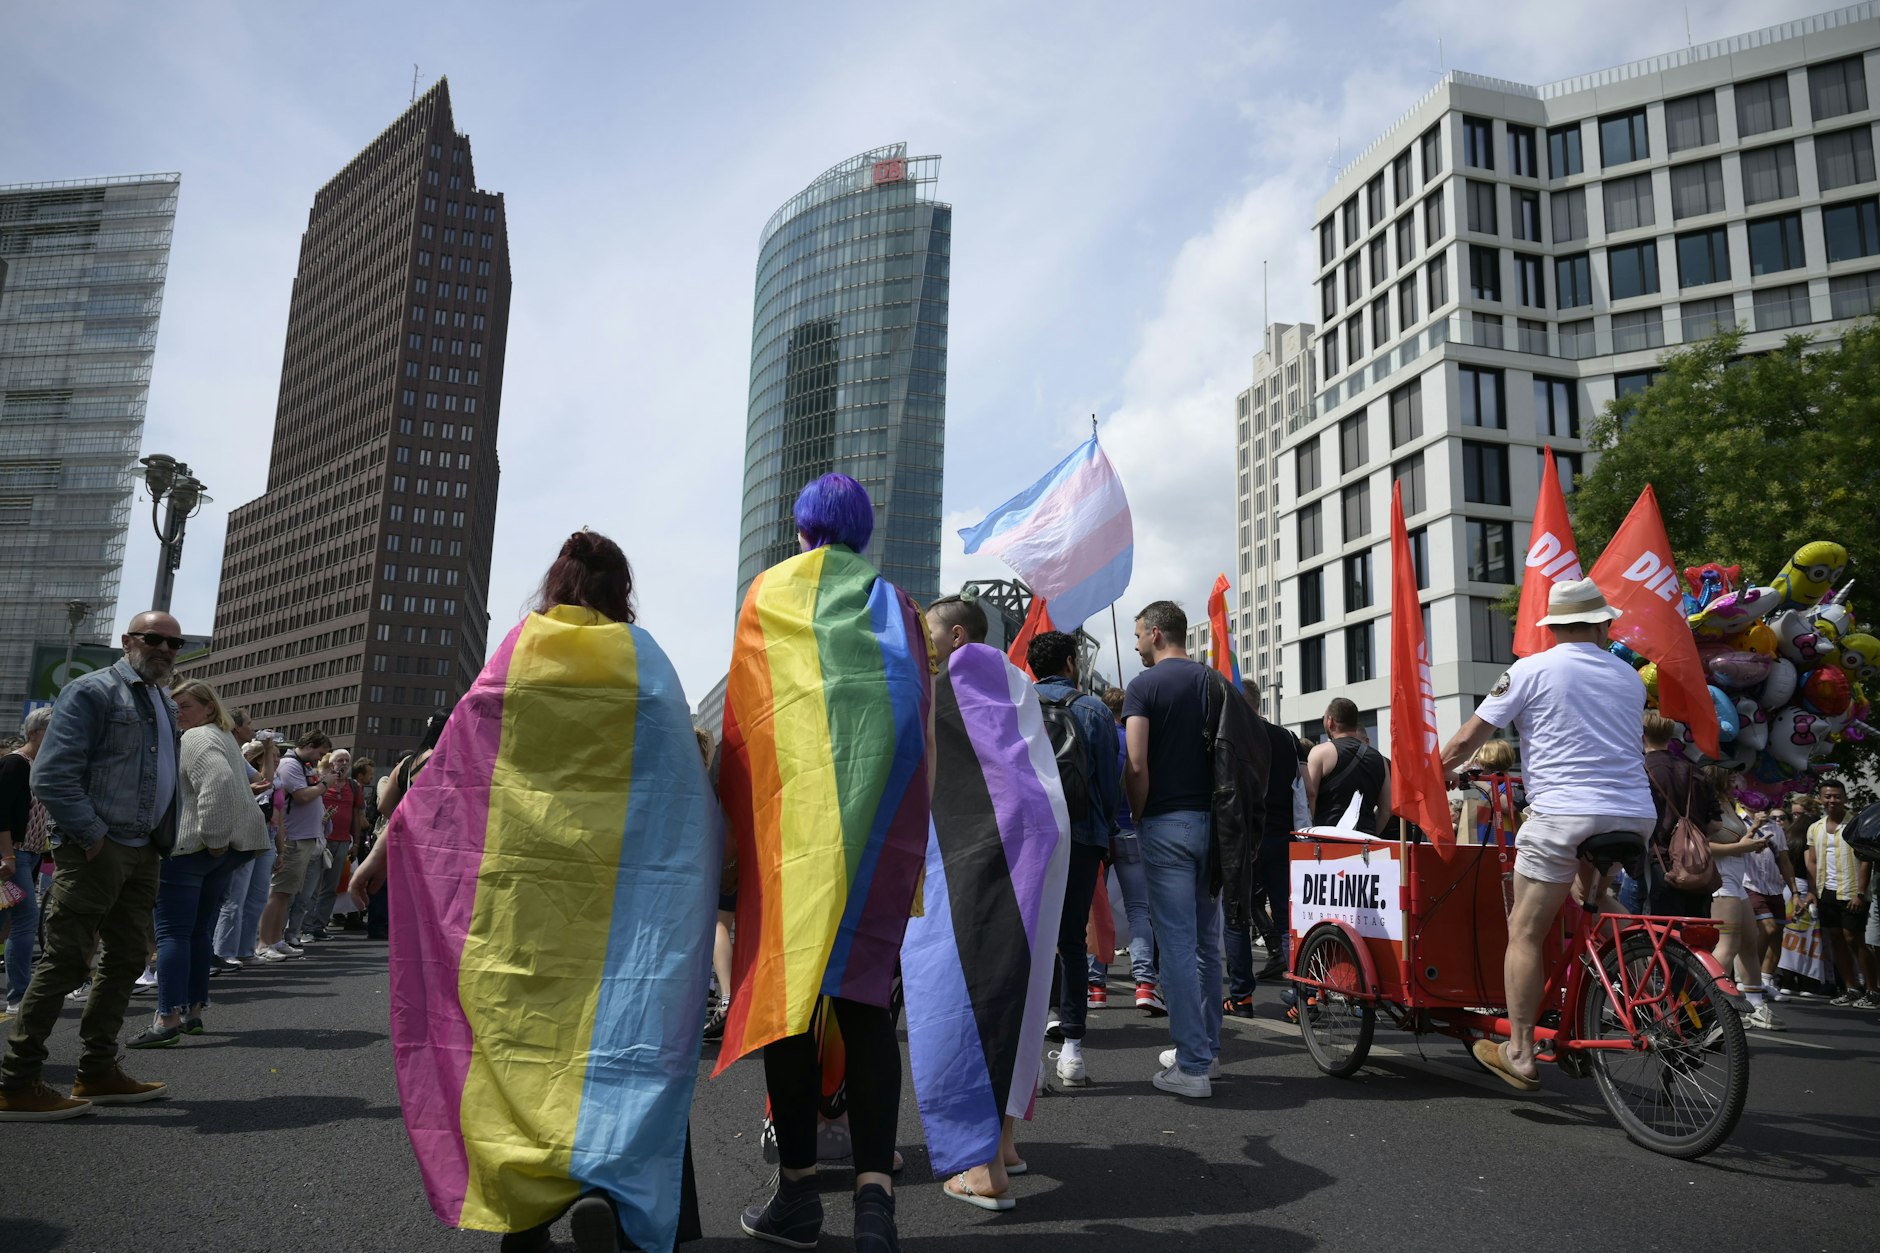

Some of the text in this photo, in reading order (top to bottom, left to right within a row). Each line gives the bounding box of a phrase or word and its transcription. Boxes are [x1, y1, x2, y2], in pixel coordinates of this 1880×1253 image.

[1621, 550, 1681, 602] DIE
[1302, 873, 1327, 906] DIE
[1302, 911, 1314, 921] IM
[1781, 932, 1825, 960] OLL
